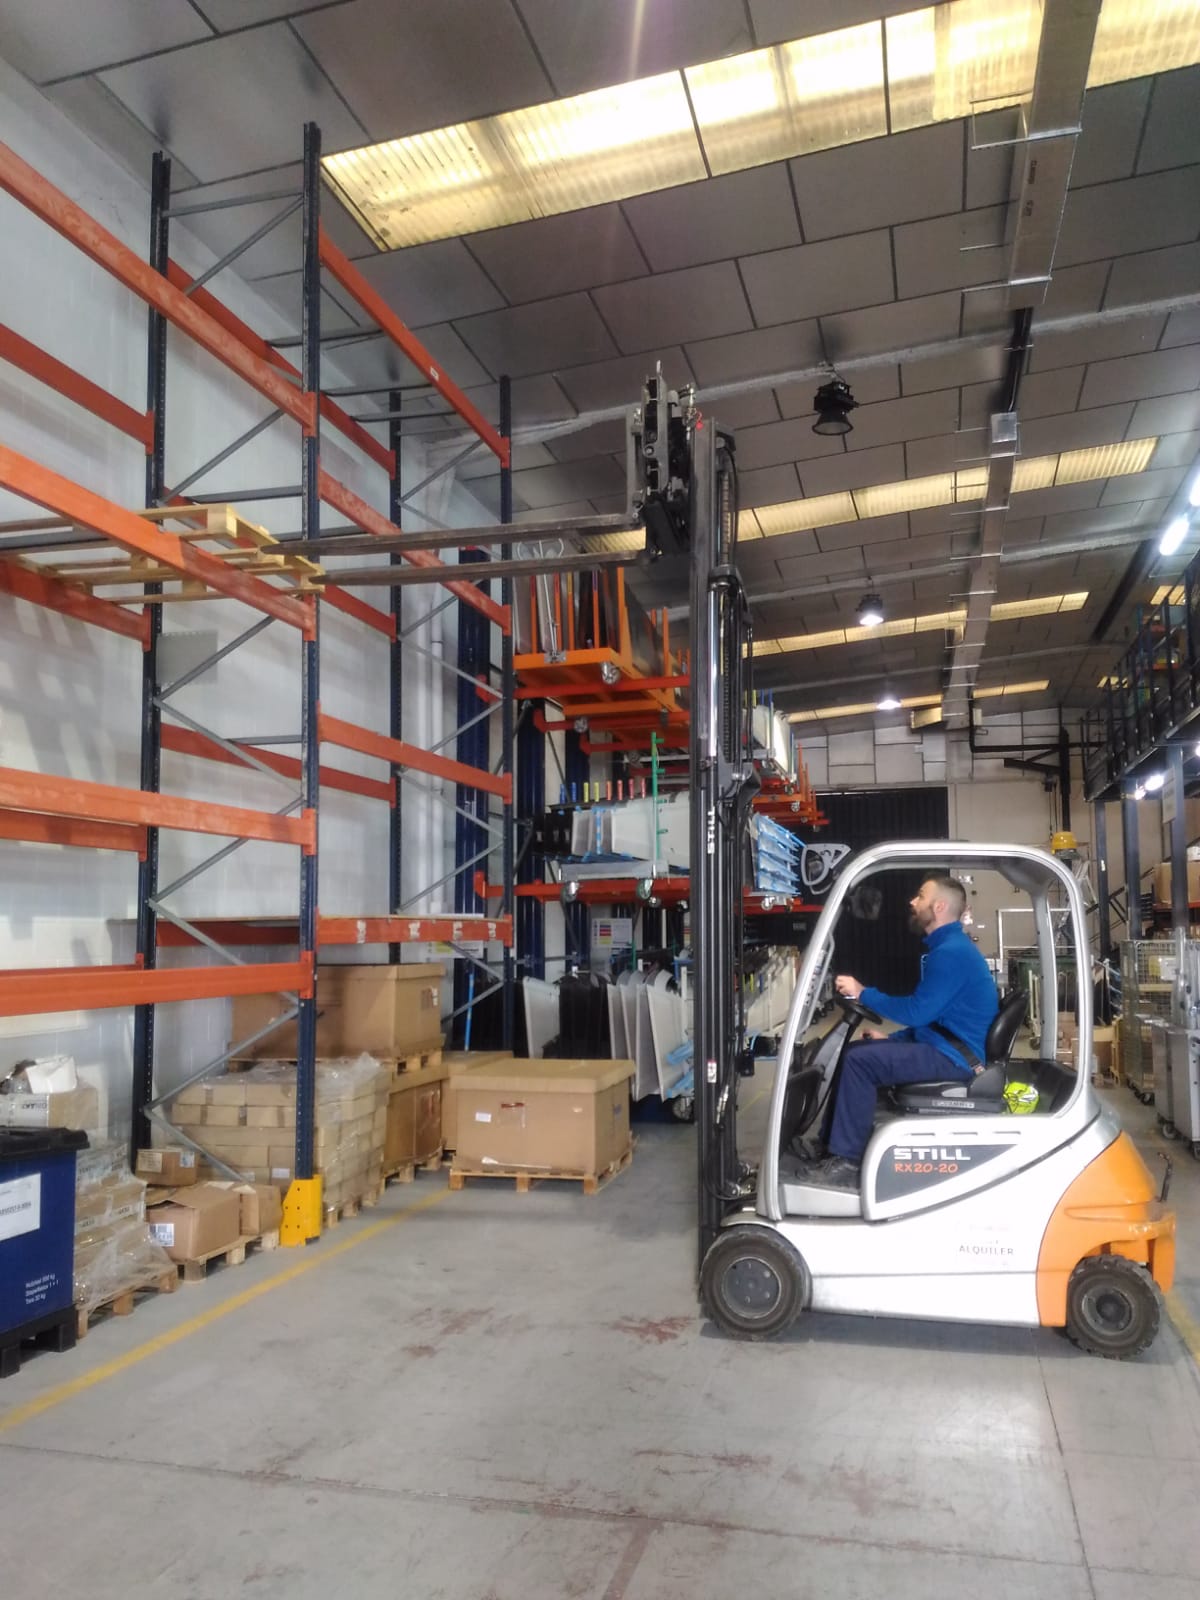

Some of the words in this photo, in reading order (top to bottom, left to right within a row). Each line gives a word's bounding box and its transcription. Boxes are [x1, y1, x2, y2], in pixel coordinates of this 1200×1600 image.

[707, 806, 715, 854] STILL
[893, 1148, 971, 1161] STILL
[894, 1163, 959, 1173] RX20-20
[959, 1244, 1014, 1256] ALQUILER
